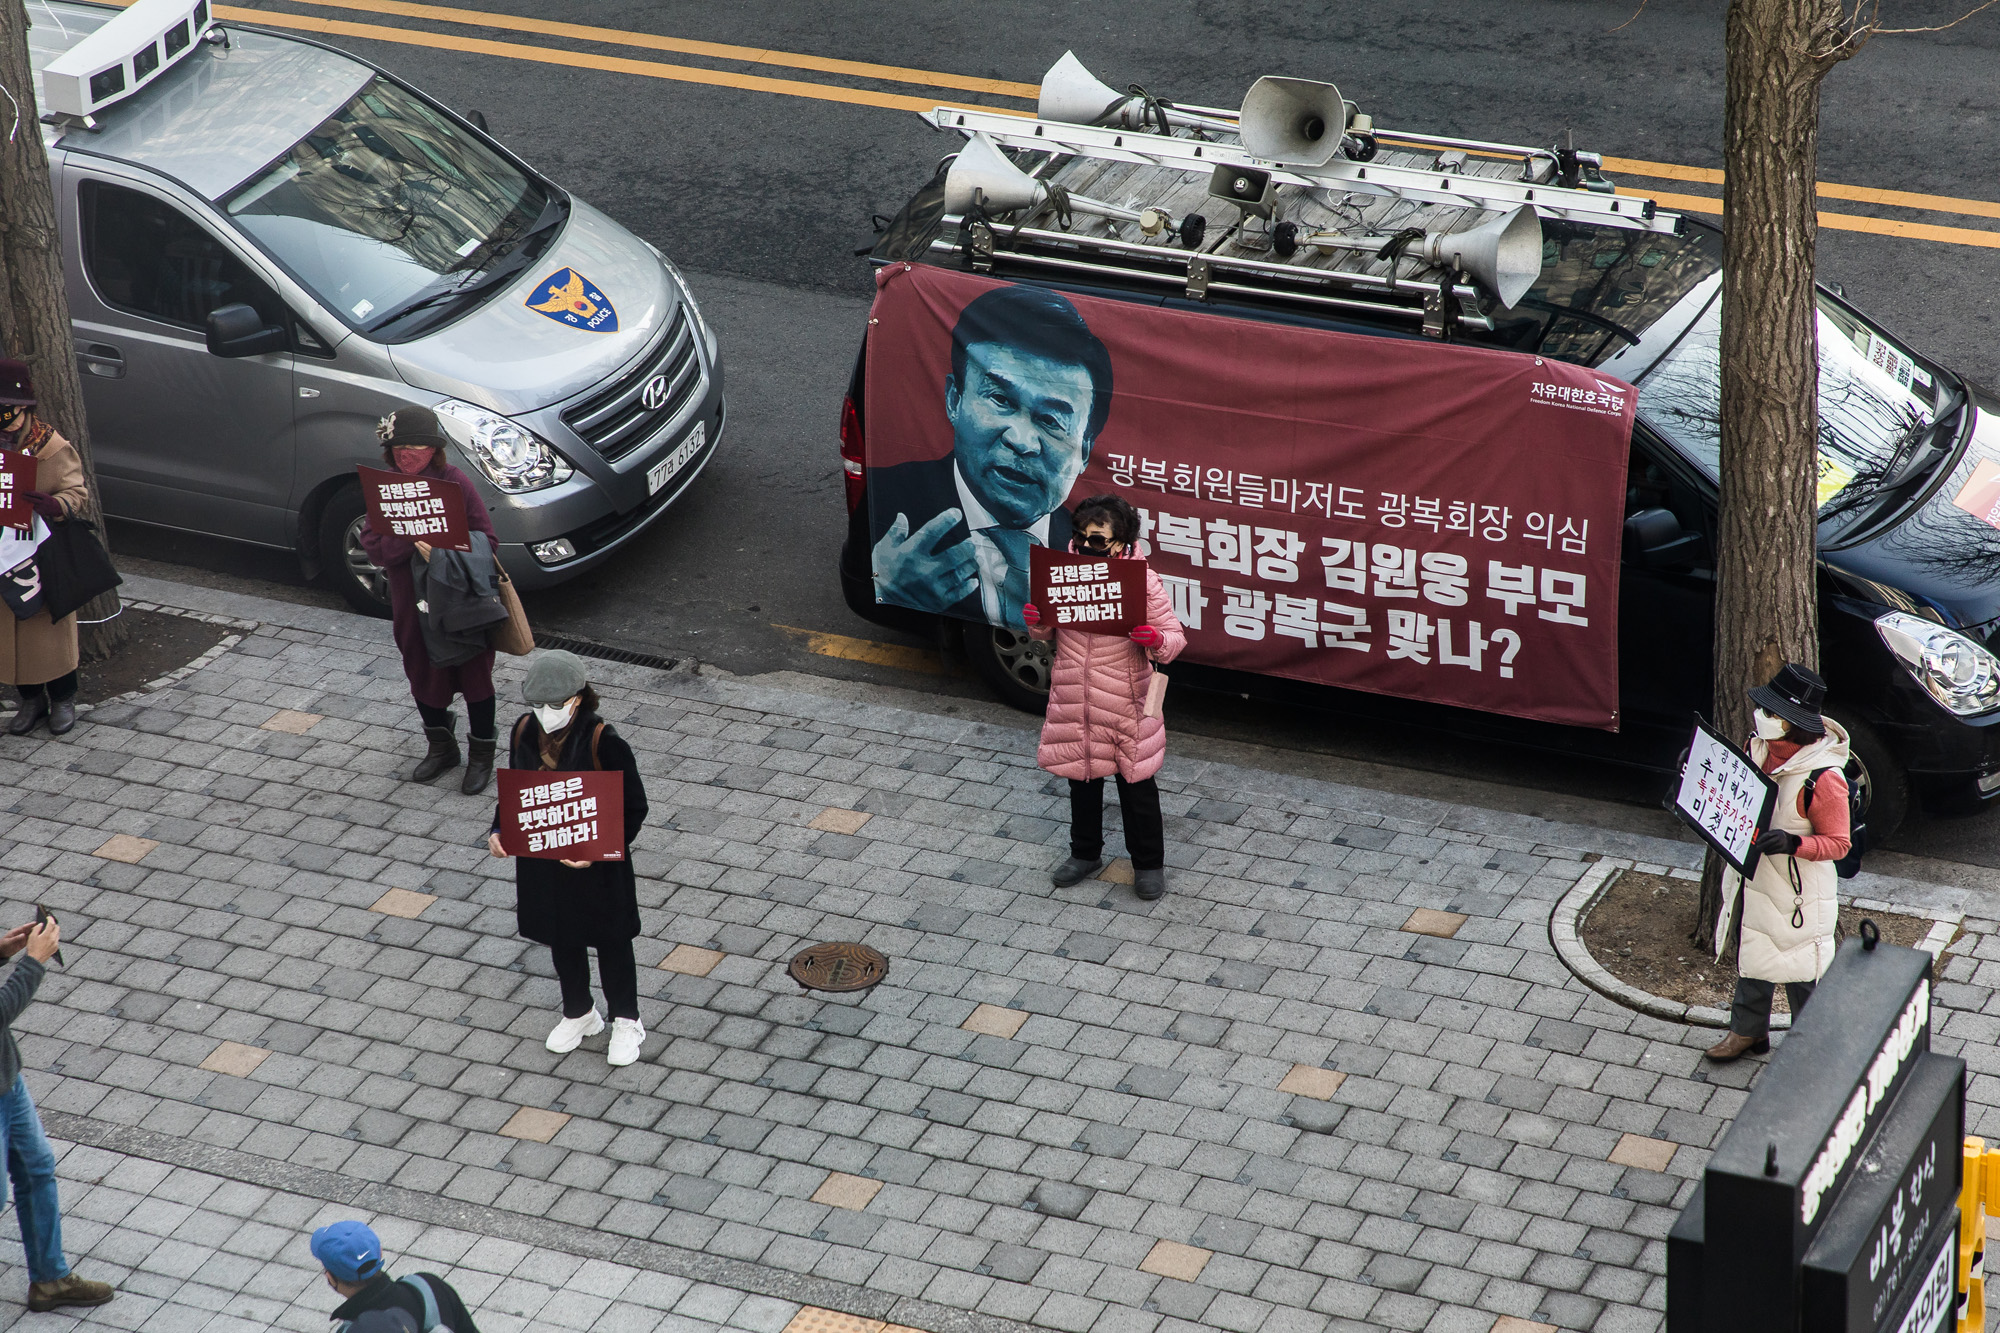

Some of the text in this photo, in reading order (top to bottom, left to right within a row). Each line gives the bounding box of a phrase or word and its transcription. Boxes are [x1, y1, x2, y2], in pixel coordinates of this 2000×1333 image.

[587, 307, 612, 329] POLICE
[1530, 397, 1551, 406] Freedom
[1566, 403, 1586, 411] National
[1587, 406, 1606, 414] Defence
[1531, 382, 1625, 411] 자유대한호국단
[654, 430, 701, 488] 77라 6132
[378, 480, 431, 500] 김원웅은
[1107, 453, 1589, 555] 광복회원들마저도 광복회장 의심
[380, 498, 446, 518] 떳떳하다면
[391, 516, 449, 536] 공개하라!
[1050, 562, 1109, 584] 김원웅은
[1320, 537, 1470, 607] 김원웅
[1486, 560, 1589, 628] 부모
[1047, 581, 1123, 604] 떳떳하다면
[1056, 603, 1123, 624] 공개하라!
[1158, 573, 1522, 679] 짜 광복군 맞나?
[519, 776, 584, 808] 김원웅은
[517, 796, 598, 832] 떳떳하다면
[528, 820, 598, 853] 공개하라!
[1870, 1187, 1906, 1283] 비봉
